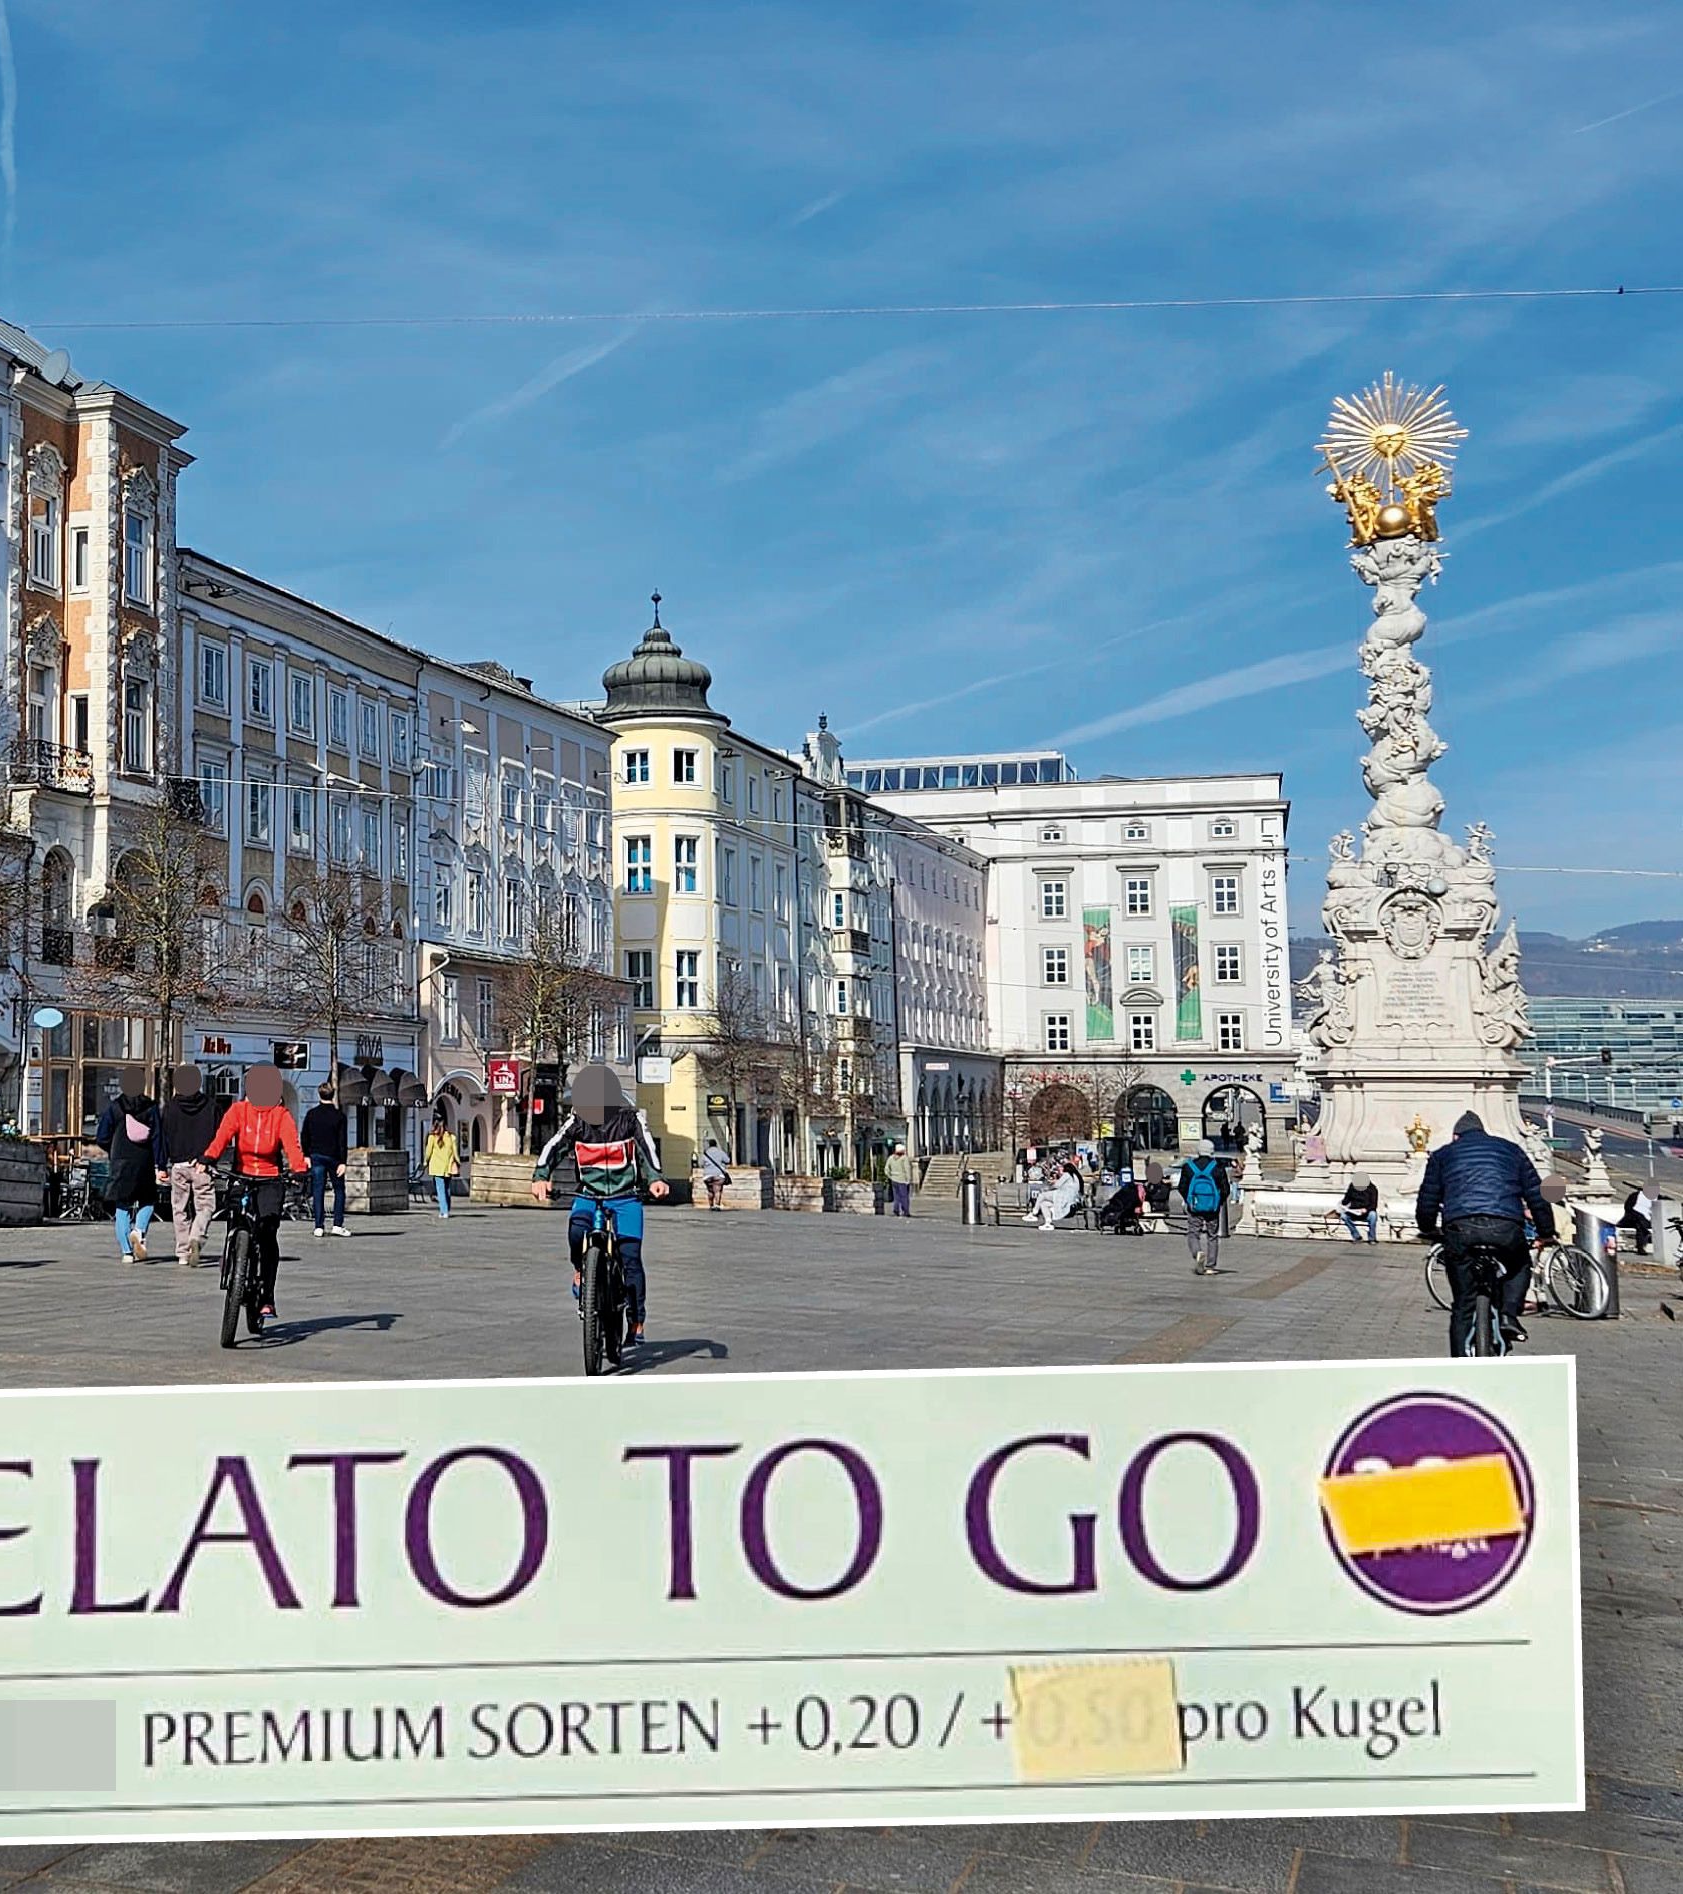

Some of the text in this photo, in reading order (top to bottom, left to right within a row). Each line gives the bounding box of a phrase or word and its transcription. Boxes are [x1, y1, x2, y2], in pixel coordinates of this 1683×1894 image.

[1260, 817, 1283, 1047] University of Arts Linz
[493, 1075, 516, 1084] LINZ
[1203, 1073, 1264, 1083] APOTHEKE
[622, 1437, 883, 1600] TO
[965, 1431, 1260, 1595] GO
[143, 1705, 446, 1767] PREMIUM
[467, 1699, 720, 1759] SORTEN
[747, 1692, 920, 1755] +0,20
[938, 1690, 965, 1748] /
[1177, 1700, 1269, 1768] pro
[1292, 1679, 1442, 1760] Kugel
